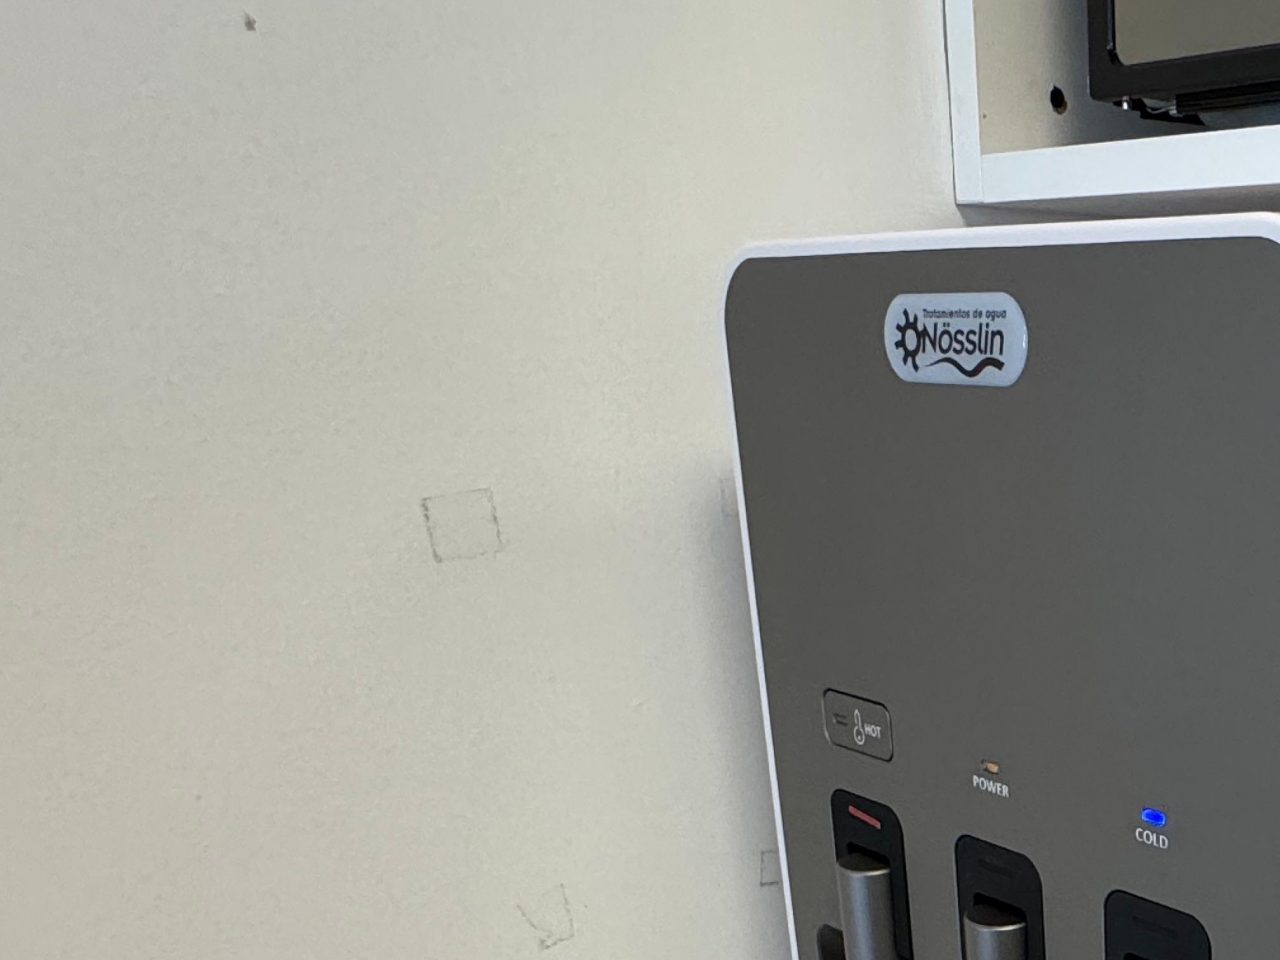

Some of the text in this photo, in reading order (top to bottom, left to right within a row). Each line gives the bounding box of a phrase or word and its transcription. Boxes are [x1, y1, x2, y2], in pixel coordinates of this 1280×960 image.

[922, 308, 1007, 321] Tratamientos de agua
[864, 722, 881, 739] HOT
[972, 774, 1009, 798] POWER
[1135, 827, 1169, 849] COLD
